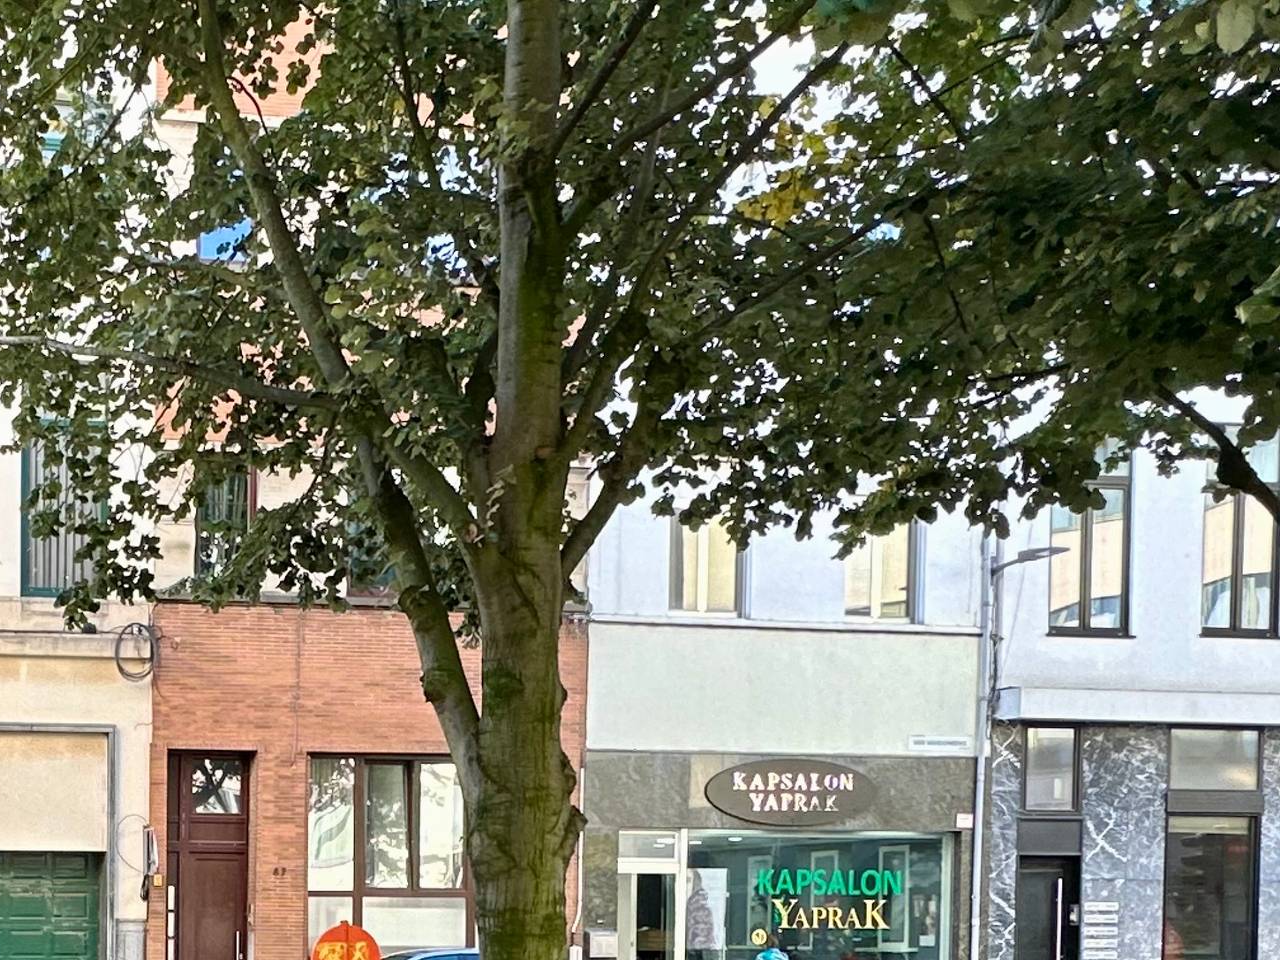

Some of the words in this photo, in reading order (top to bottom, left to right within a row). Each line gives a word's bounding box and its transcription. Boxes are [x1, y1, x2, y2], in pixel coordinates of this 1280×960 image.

[732, 771, 854, 791] KAPSALON
[749, 793, 839, 812] YAPRAK
[757, 868, 903, 896] KAPSALON
